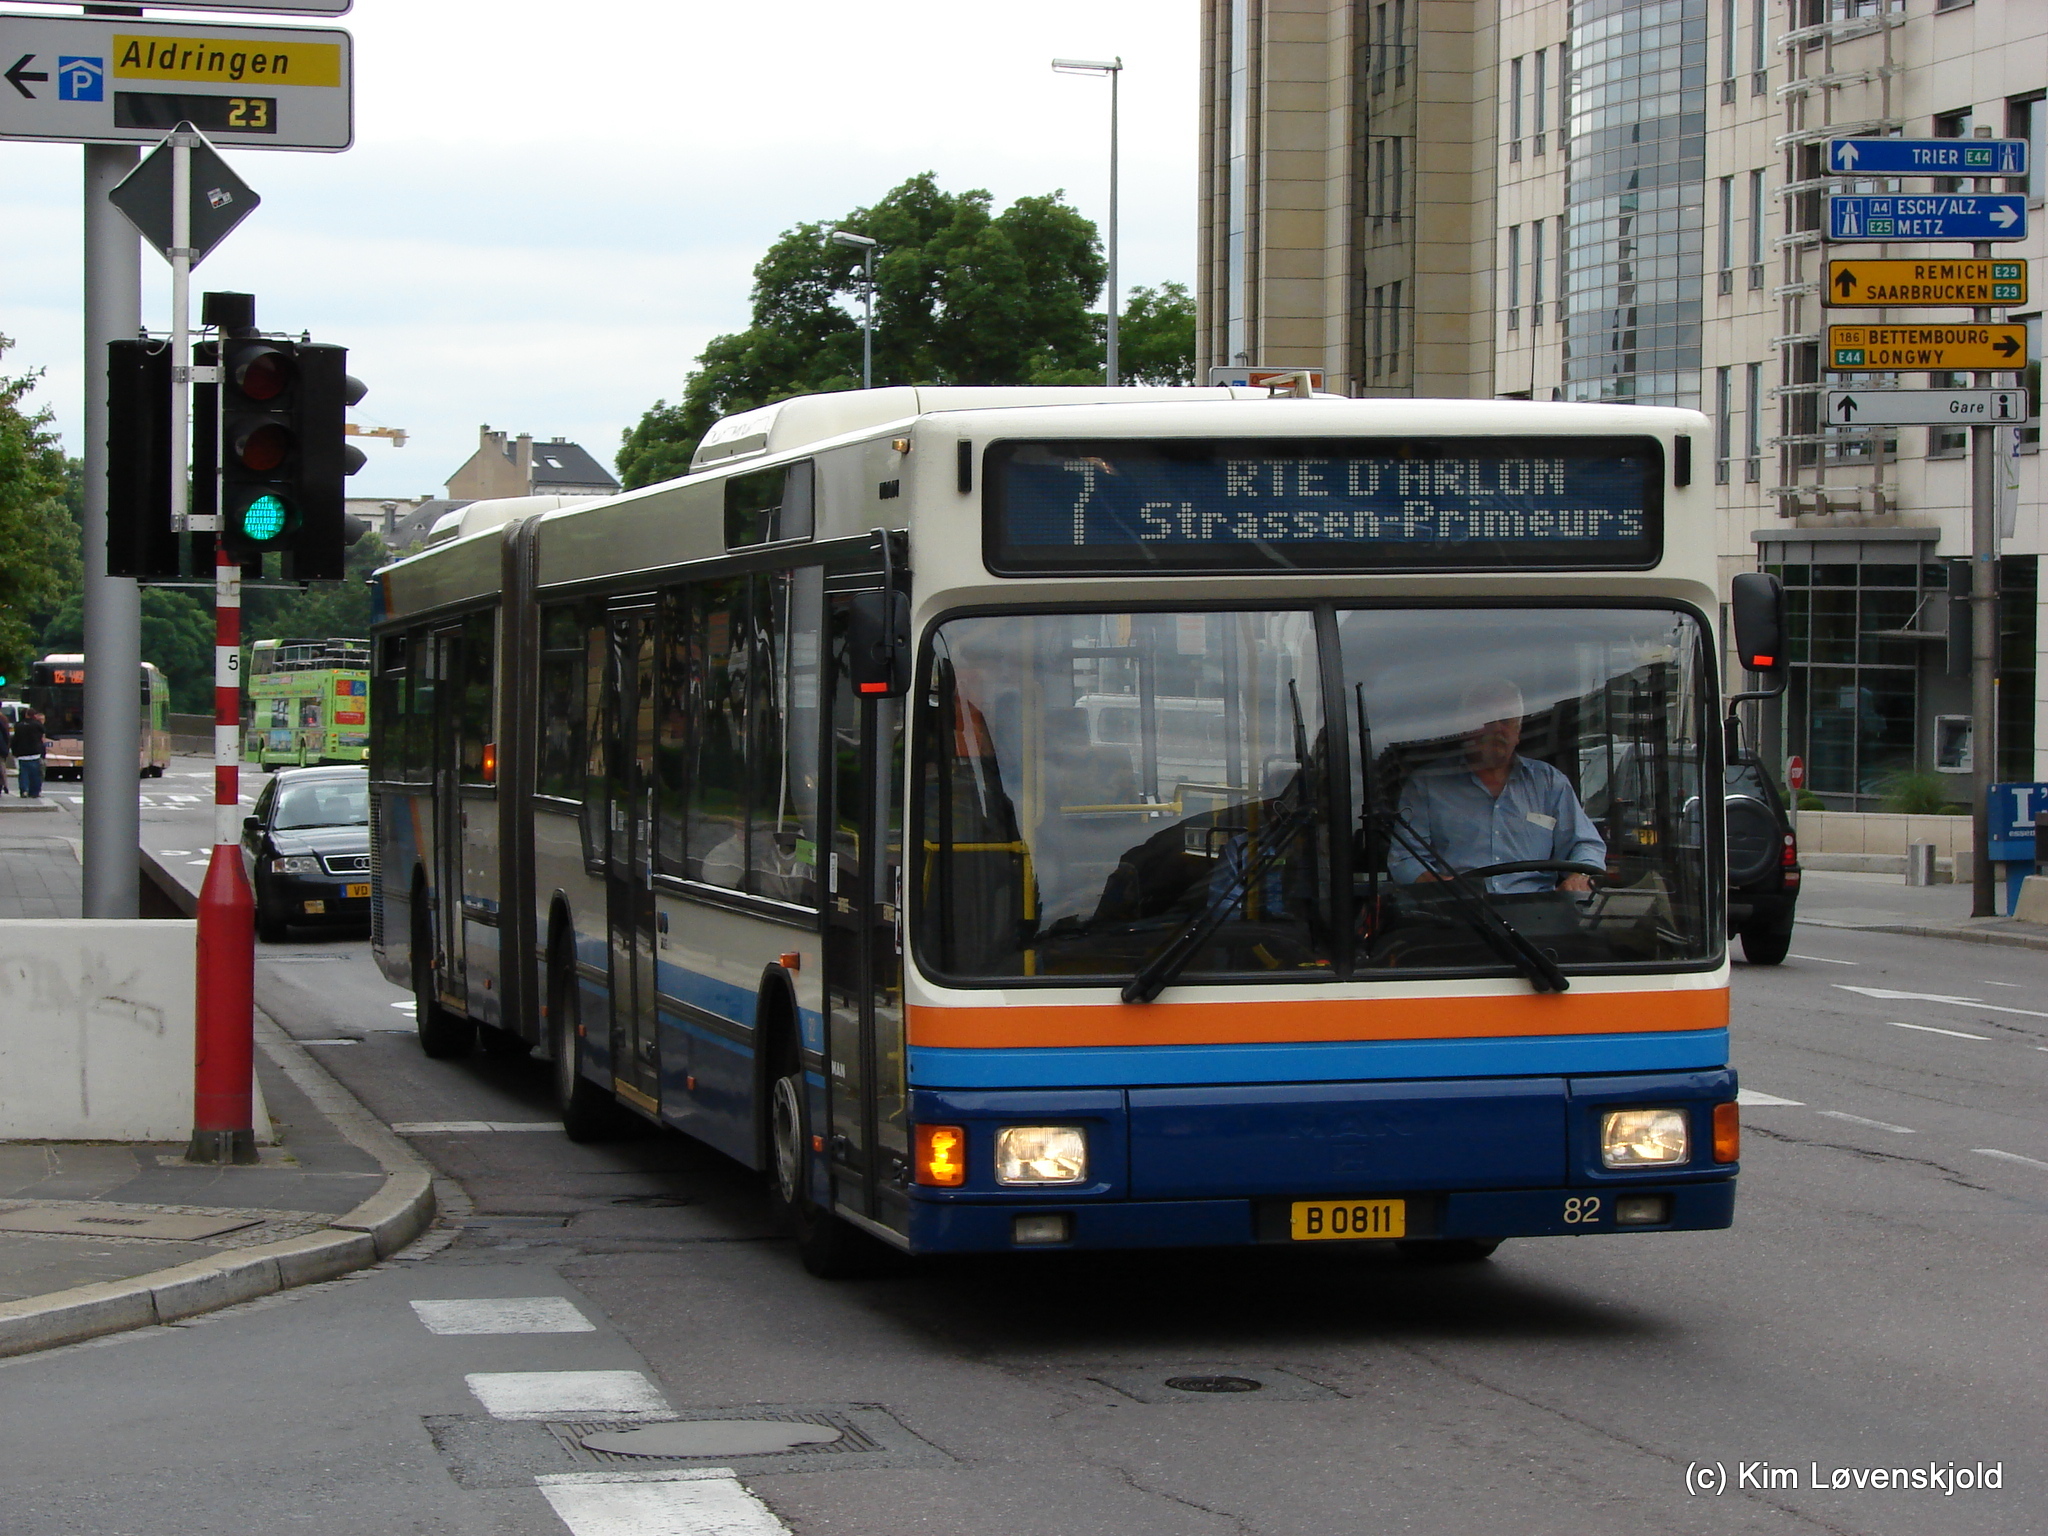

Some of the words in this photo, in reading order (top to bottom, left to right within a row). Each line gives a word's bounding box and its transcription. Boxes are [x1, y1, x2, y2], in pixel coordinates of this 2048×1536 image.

[120, 40, 290, 81] Aldringen
[71, 70, 93, 99] P
[229, 98, 268, 128] 23
[1912, 149, 1959, 164] TRIER
[1967, 151, 1990, 163] E44
[1873, 202, 1888, 213] A4
[1897, 198, 1982, 216] ESCH/ALZ.
[1869, 222, 1892, 233] E25
[1898, 219, 1944, 235] METZ
[1915, 265, 1988, 280] REMICH
[1995, 266, 2017, 278] E29
[1866, 284, 1988, 300] SAARBRUCKEN
[1995, 286, 2017, 297] E29
[1839, 332, 1860, 343] 186
[1869, 330, 1989, 345] BETTEMBOURG
[1838, 352, 1861, 363] E44
[1869, 349, 1944, 365] LONGWY
[1949, 400, 1984, 414] Gare
[1226, 458, 1329, 498] RTE
[1348, 457, 1565, 498] D'ARLON
[1063, 459, 1097, 546] 7
[1138, 498, 1645, 542] Strassen-Primeurs
[227, 654, 239, 671] 5
[1307, 1206, 1323, 1234] B
[1332, 1204, 1391, 1234] 0811
[1563, 1196, 1601, 1225] 82
